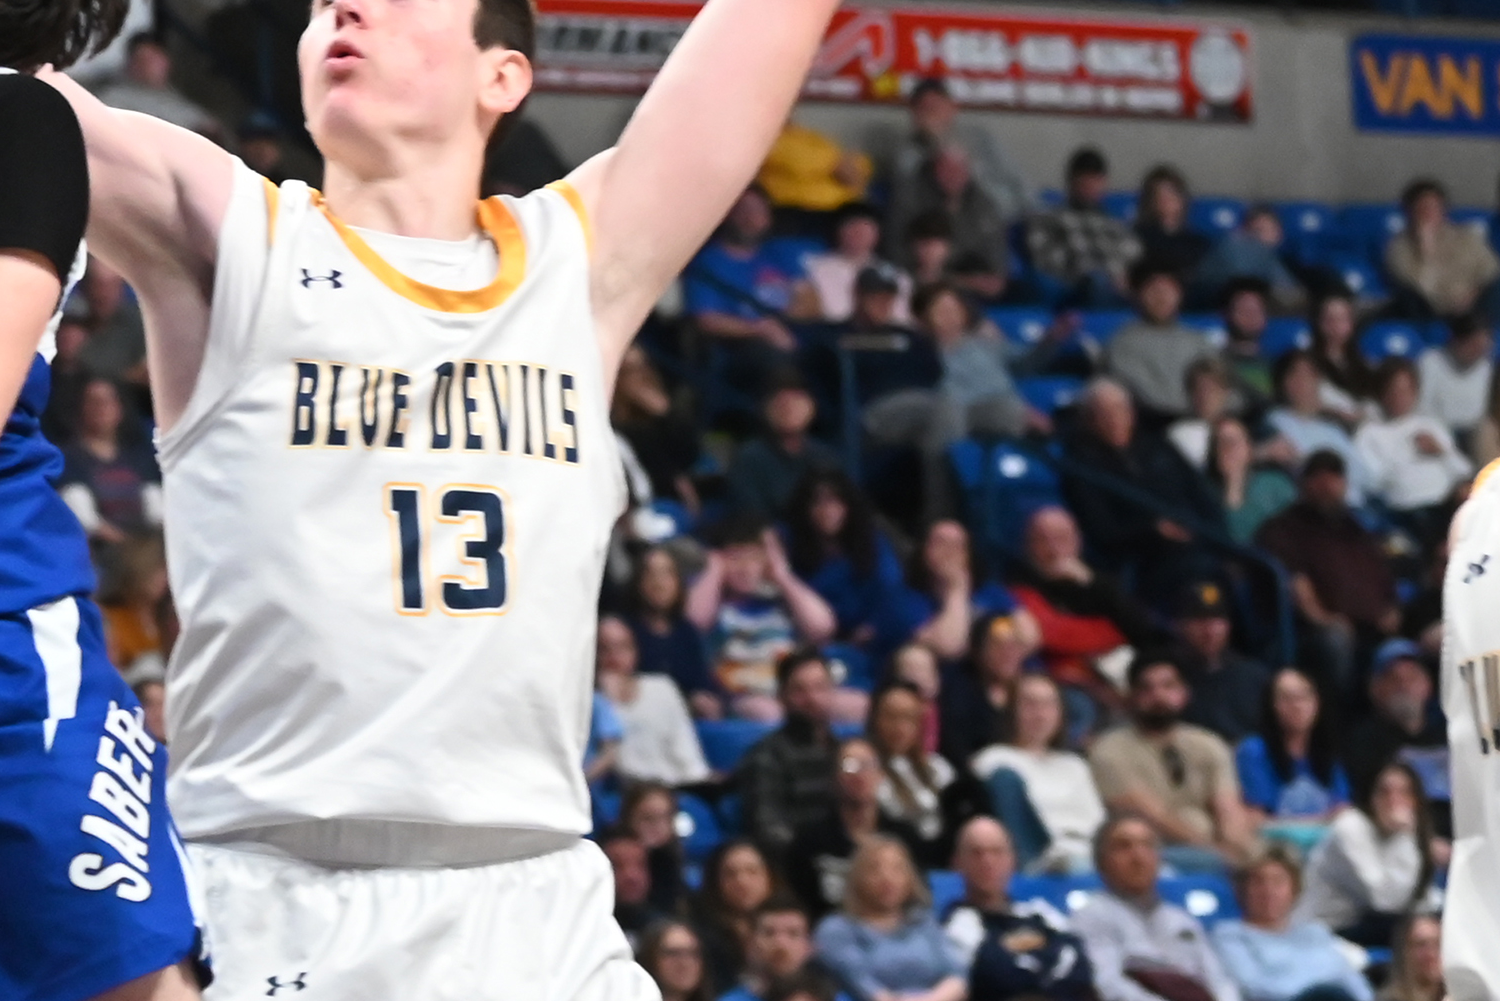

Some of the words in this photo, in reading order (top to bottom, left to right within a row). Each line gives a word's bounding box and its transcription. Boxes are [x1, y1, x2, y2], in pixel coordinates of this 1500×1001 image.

[1359, 48, 1484, 121] VAN
[290, 356, 412, 451] BLUE
[427, 357, 584, 467] DEVILS
[382, 480, 519, 618] 13
[68, 700, 156, 902] SABER
